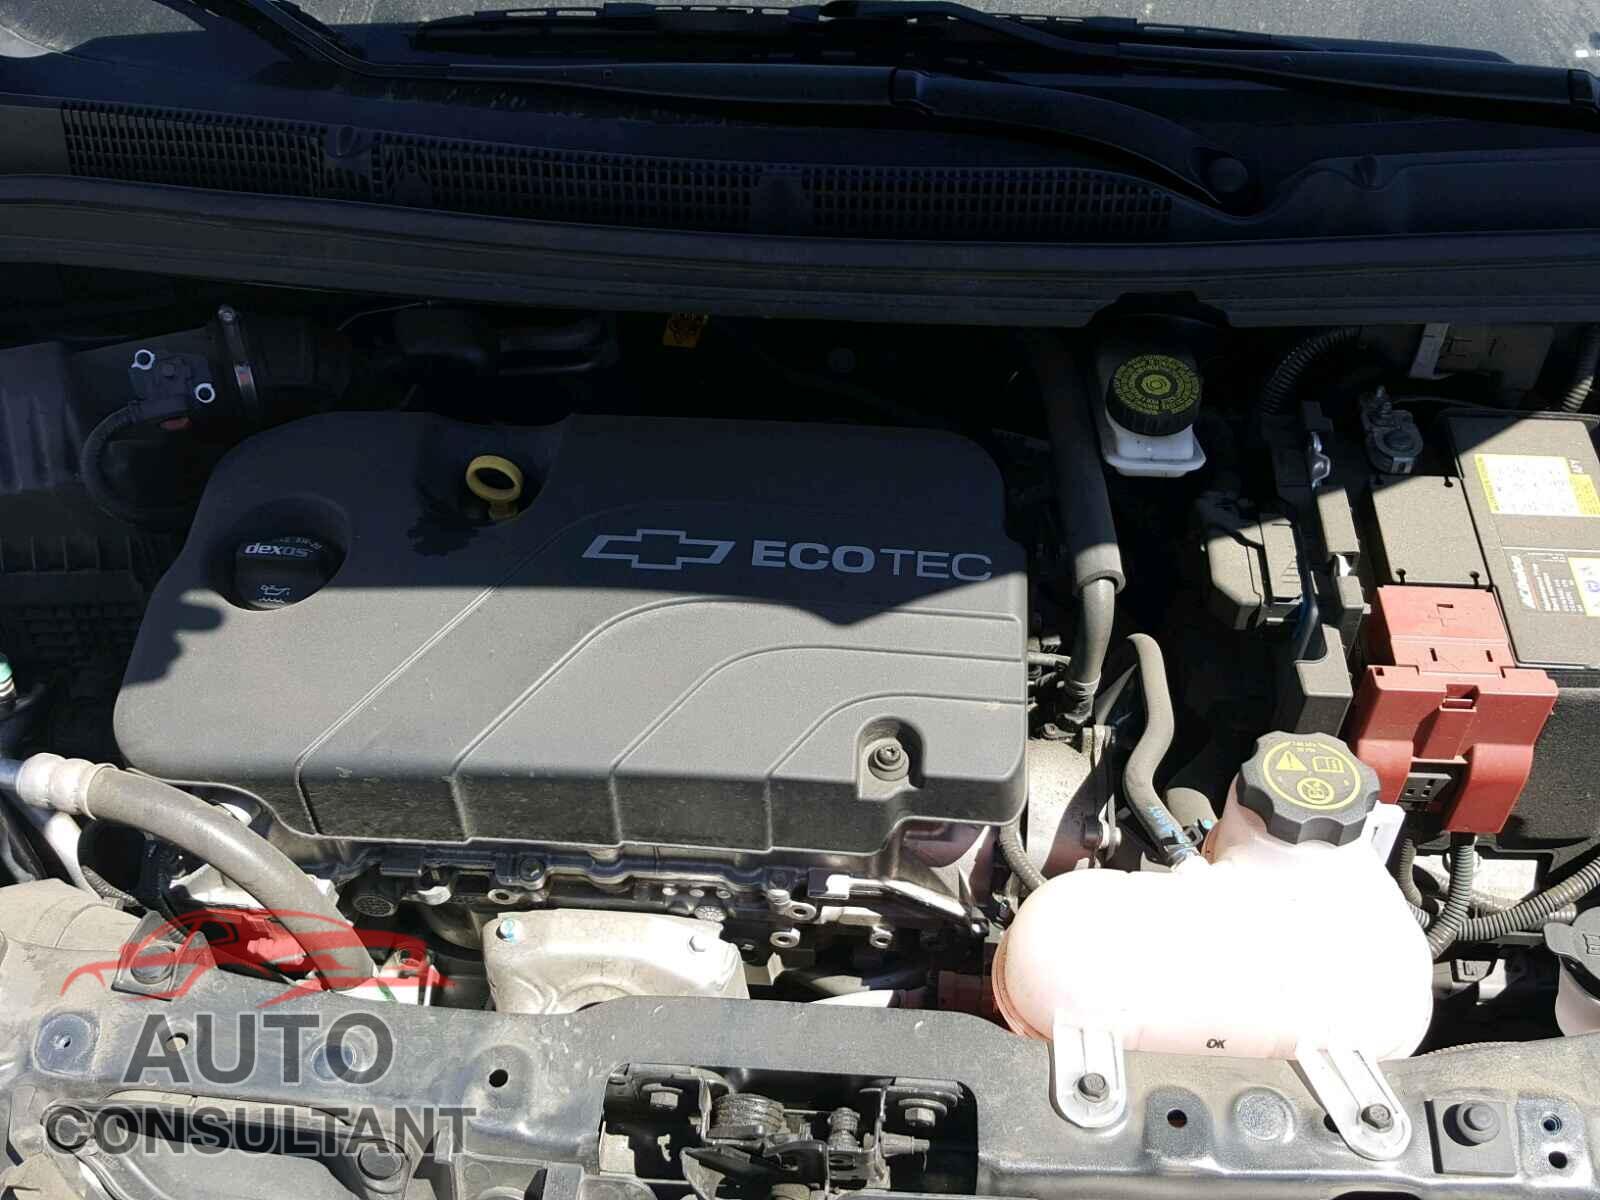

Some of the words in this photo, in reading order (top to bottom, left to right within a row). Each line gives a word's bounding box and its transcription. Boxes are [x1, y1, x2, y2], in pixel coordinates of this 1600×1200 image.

[244, 542, 309, 558] dexos
[751, 540, 992, 582] ECOTEC
[1206, 1038, 1226, 1049] OK
